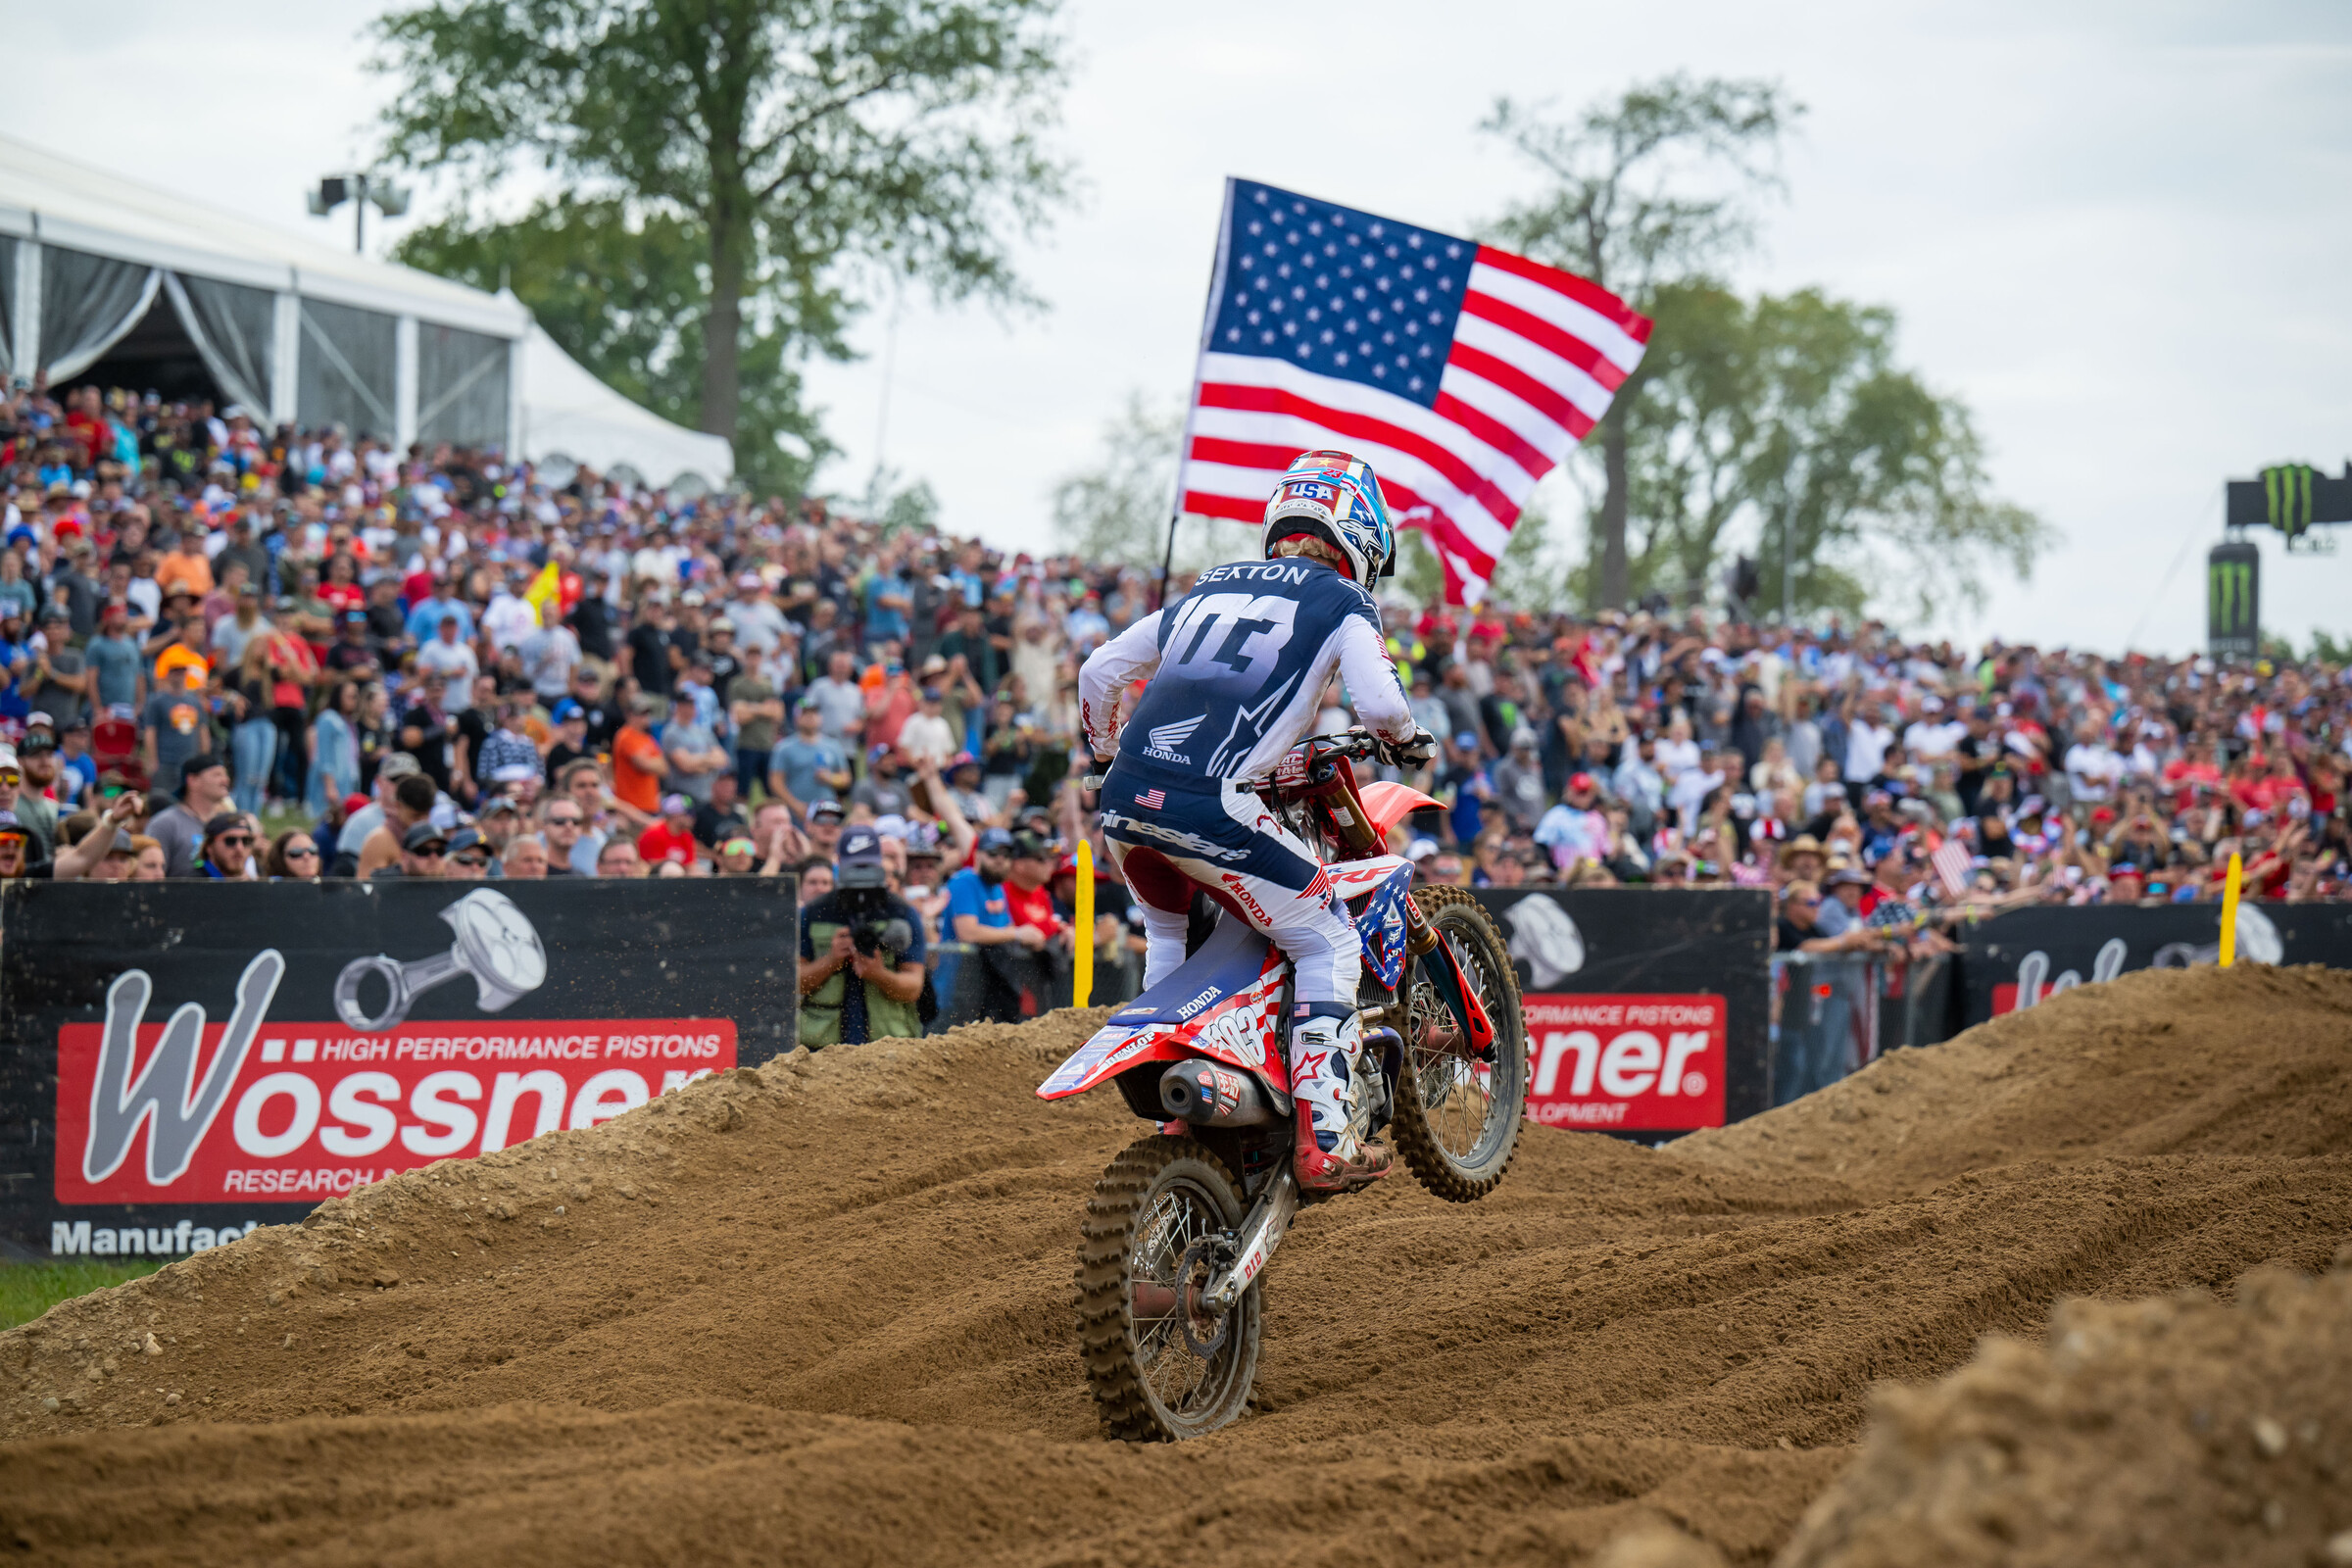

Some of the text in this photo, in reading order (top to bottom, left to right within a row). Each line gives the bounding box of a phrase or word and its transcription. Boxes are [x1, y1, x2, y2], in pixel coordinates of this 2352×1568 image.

[1195, 564, 1310, 586] SEXTON
[1153, 592, 1300, 693] 103
[1142, 746, 1192, 765] HONDA
[1229, 881, 1273, 927] HONDA
[1176, 985, 1223, 1020] HONDA
[1626, 1004, 1715, 1026] PISTONS
[321, 1034, 721, 1061] HIGH PERFORMANCE PISTONS
[1104, 1031, 1156, 1068] DUNLOP
[1208, 1005, 1267, 1068] 103
[83, 949, 712, 1187] Wössne
[223, 1168, 374, 1194] RESEARCH
[1244, 1250, 1262, 1280] DID
